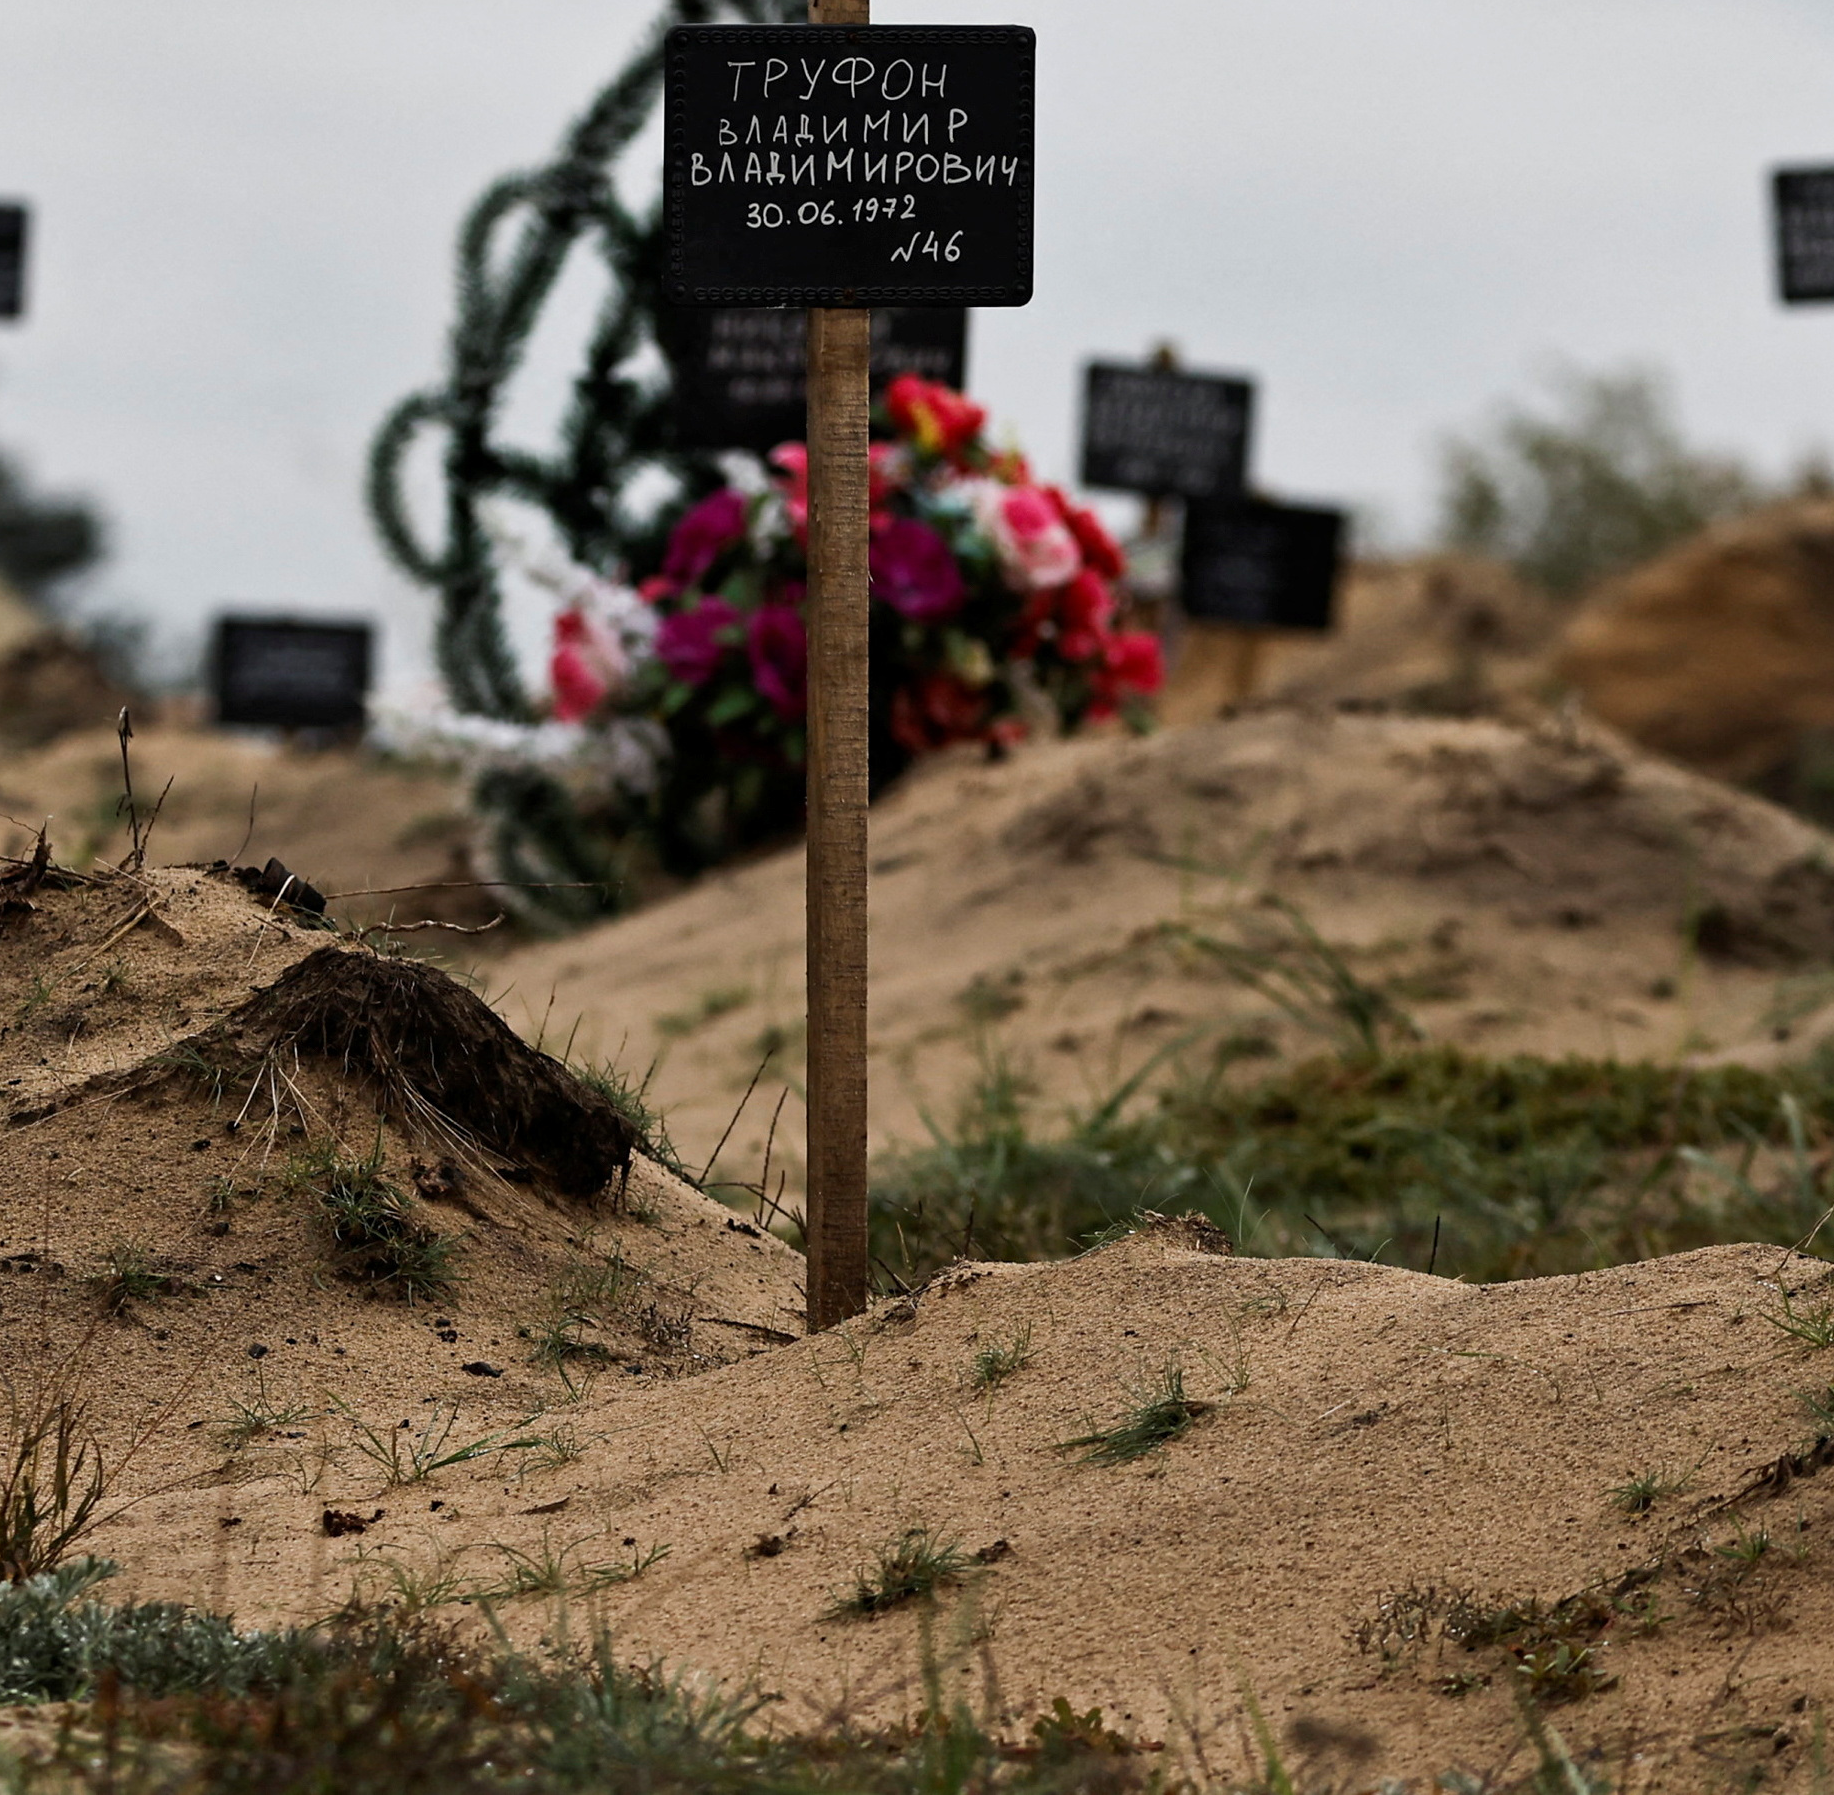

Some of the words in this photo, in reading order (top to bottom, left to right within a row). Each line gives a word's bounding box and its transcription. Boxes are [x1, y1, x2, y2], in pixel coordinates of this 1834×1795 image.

[727, 56, 947, 102] ТРУФОН
[718, 107, 968, 148] ВЛАДИМИР
[691, 147, 1019, 187] ВЛАДИМИРОВИЧ
[745, 193, 917, 229] 30.06.1972
